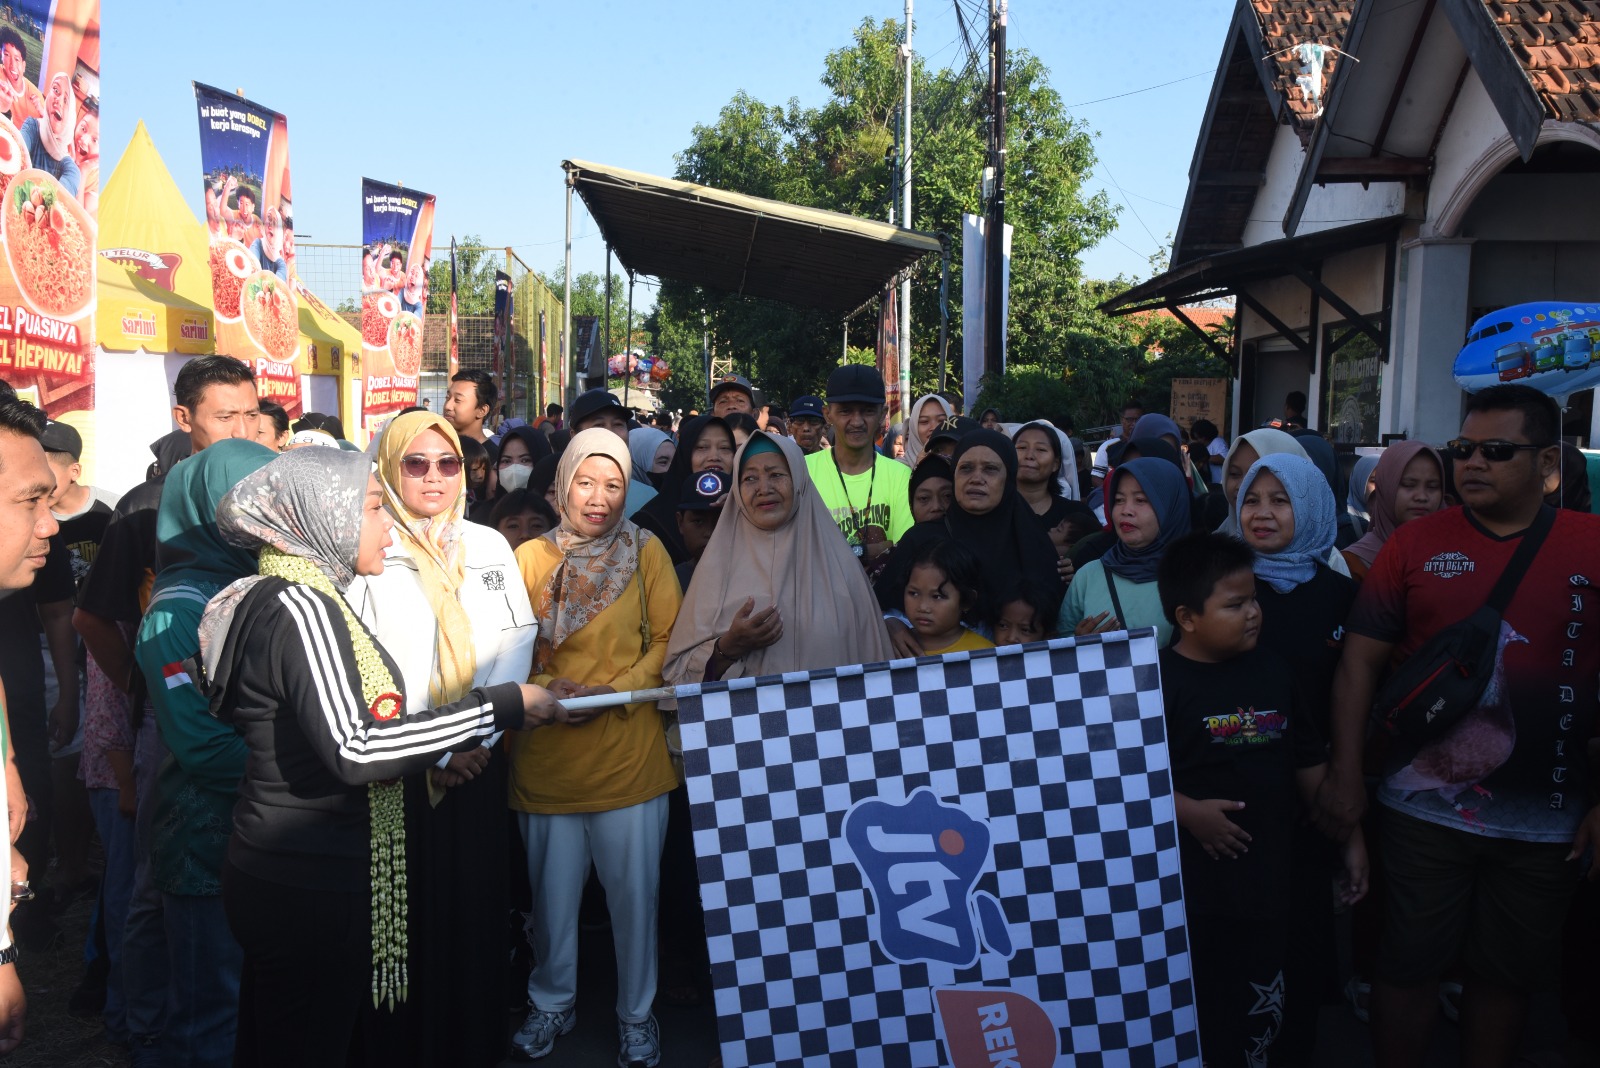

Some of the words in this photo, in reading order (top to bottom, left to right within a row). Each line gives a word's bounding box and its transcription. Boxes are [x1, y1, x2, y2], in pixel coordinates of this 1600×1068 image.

[210, 106, 229, 117] buat
[229, 109, 247, 124] yang
[247, 112, 267, 131] DOBEL
[210, 118, 230, 132] kerja
[231, 119, 260, 138] kerasnya
[402, 197, 418, 209] DOBEL
[112, 249, 149, 259] TELUR
[14, 306, 77, 344] PUASNYA
[121, 313, 156, 336] sarimi
[180, 319, 208, 340] sarimi
[14, 338, 82, 374] HEPINYA!
[256, 357, 293, 377] PUASNYA
[258, 377, 297, 397] HEPINYA!
[368, 375, 391, 391] DOBEL
[365, 390, 390, 408] DOBEL
[1445, 561, 1475, 572] DELTA
[1208, 714, 1241, 738] BAD
[1255, 712, 1286, 734] BOY
